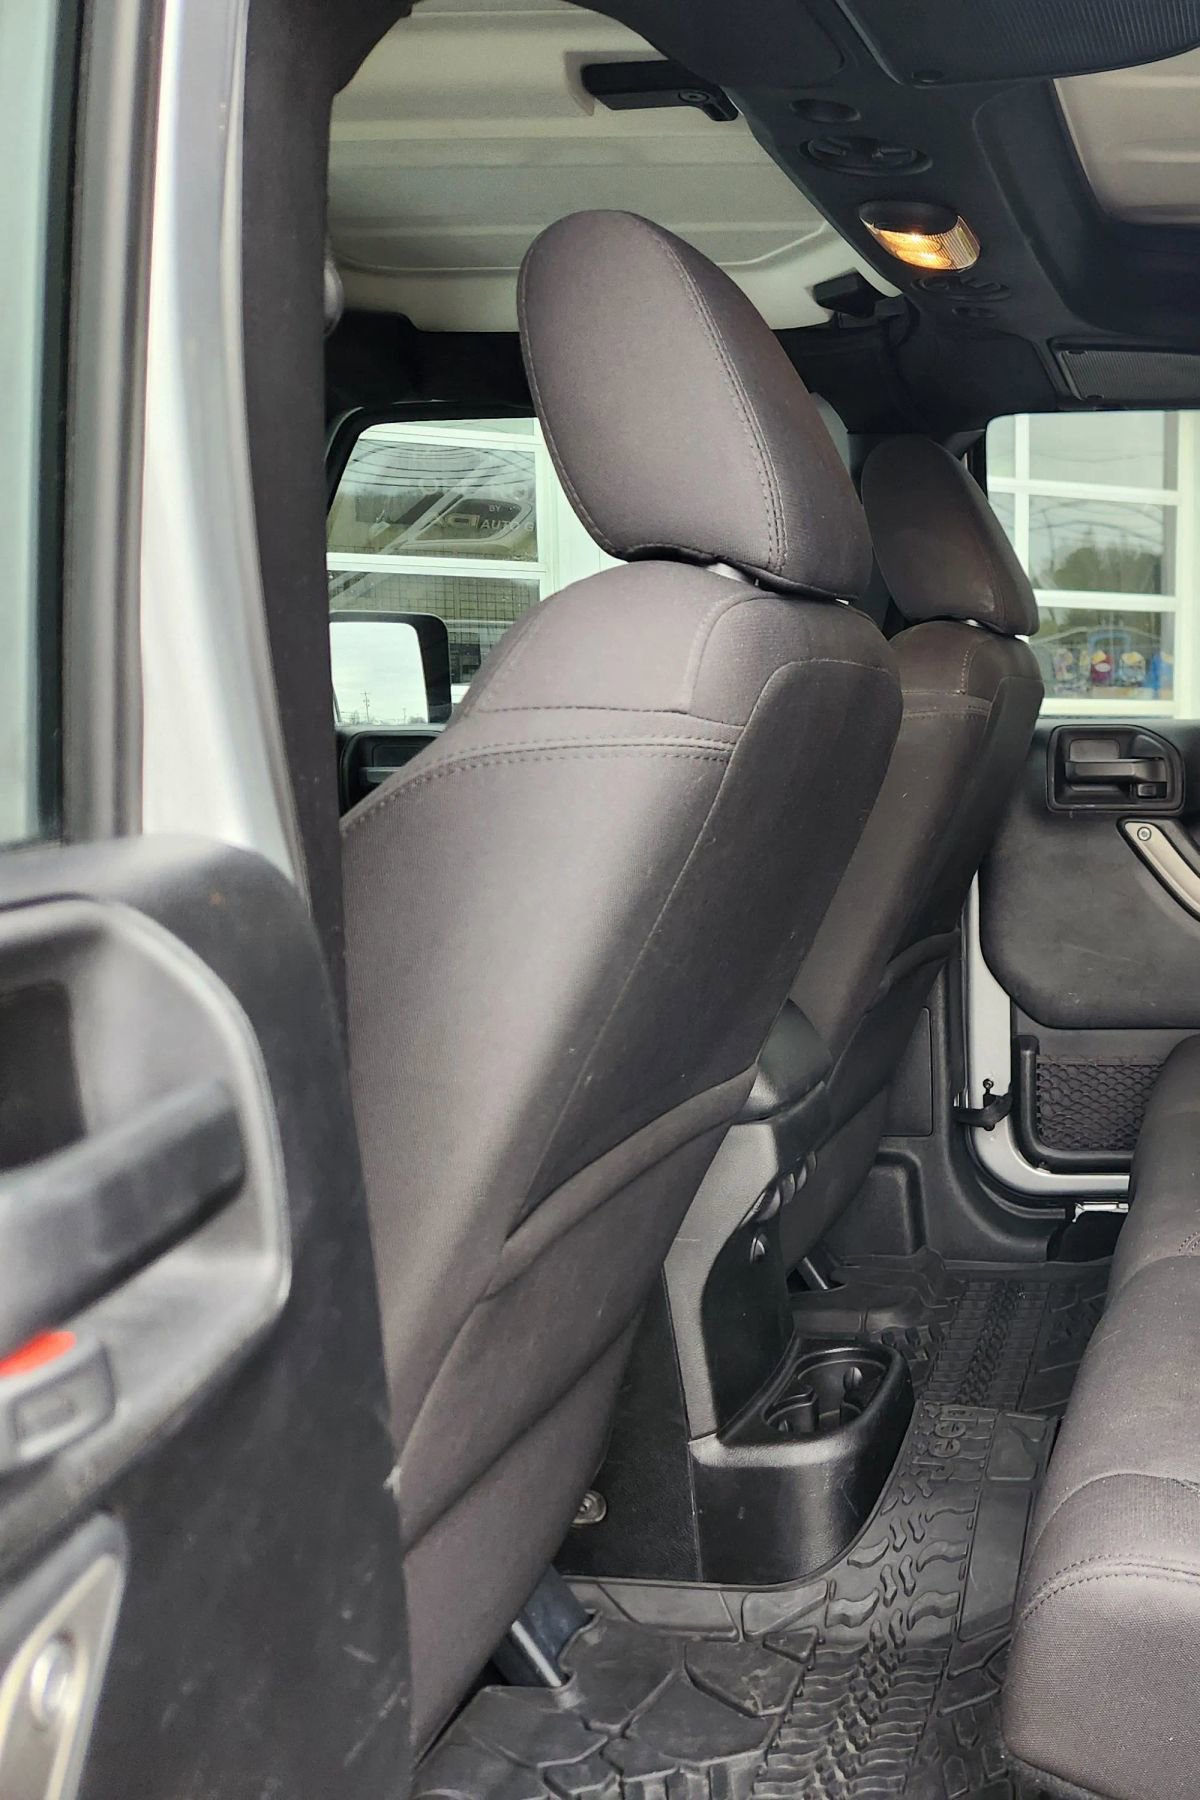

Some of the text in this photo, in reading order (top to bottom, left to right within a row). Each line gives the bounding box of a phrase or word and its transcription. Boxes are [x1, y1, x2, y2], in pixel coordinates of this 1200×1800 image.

[488, 504, 502, 512] BY
[480, 519, 520, 530] AUTO
[911, 1402, 979, 1481] Jeep
